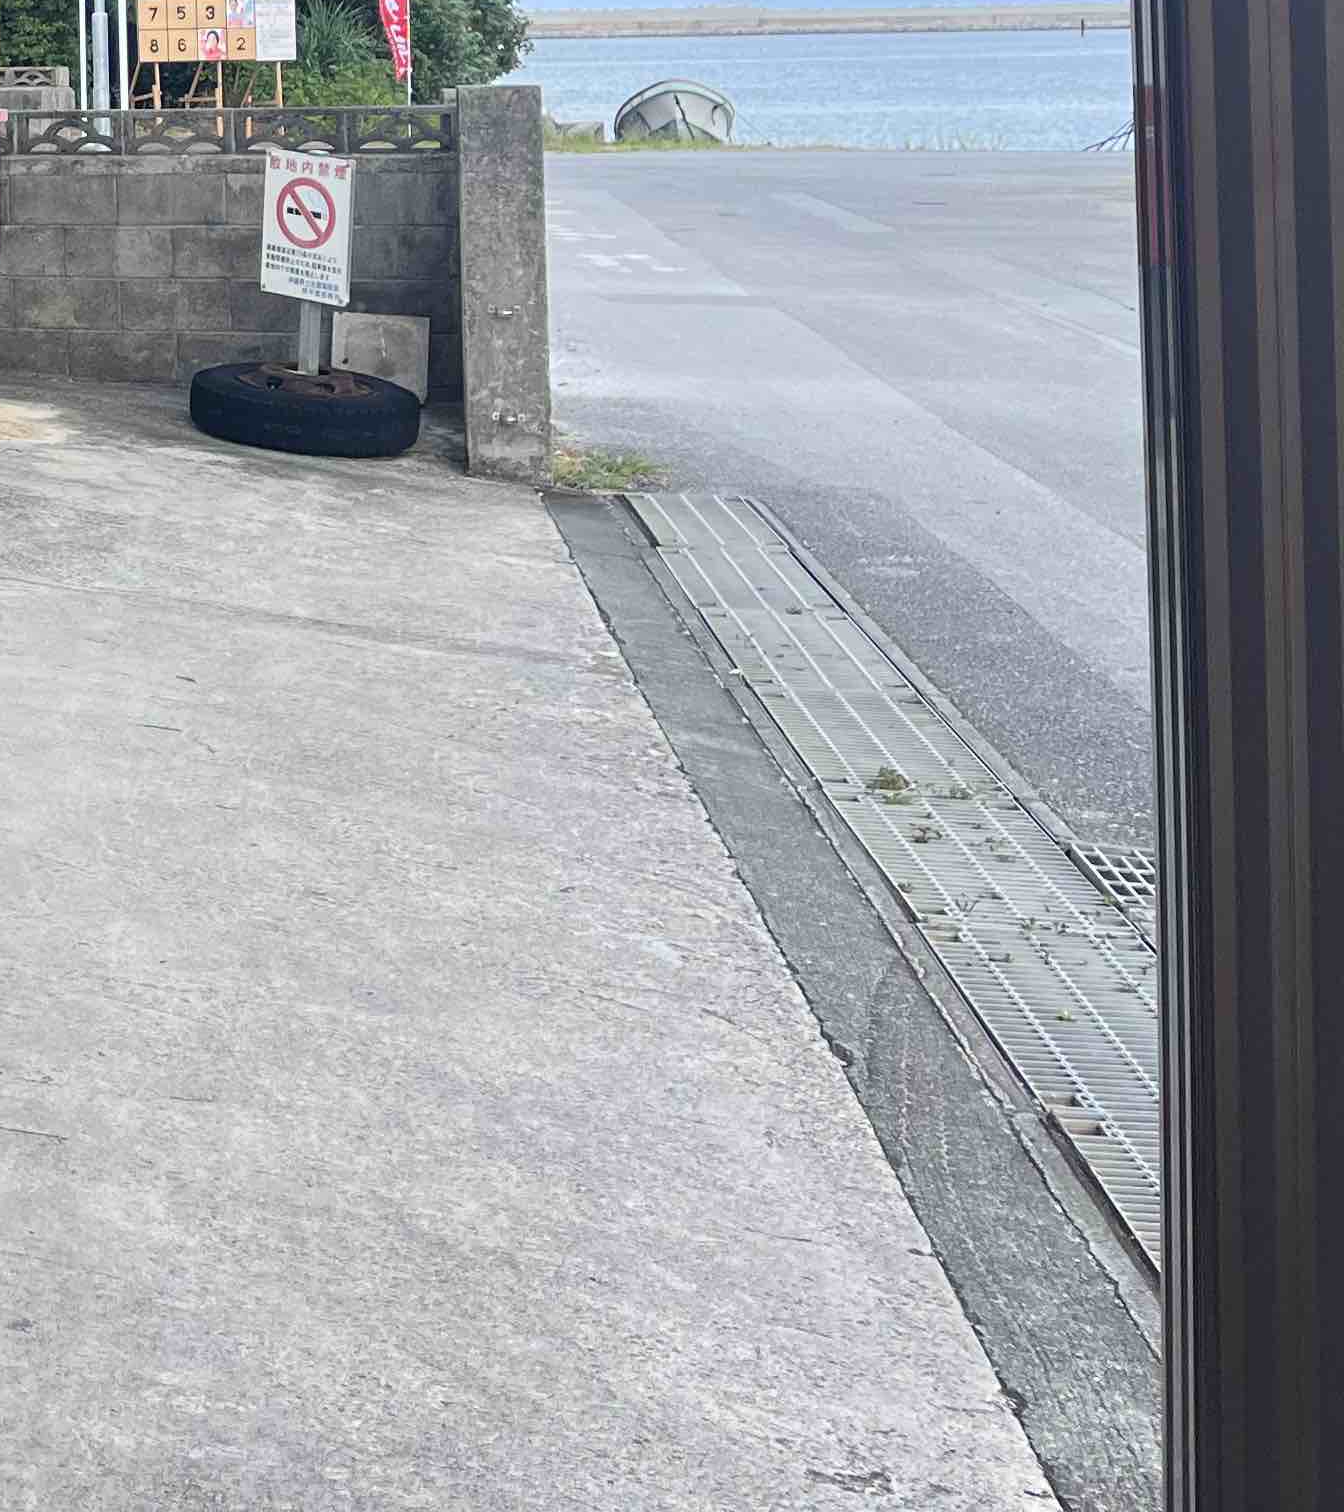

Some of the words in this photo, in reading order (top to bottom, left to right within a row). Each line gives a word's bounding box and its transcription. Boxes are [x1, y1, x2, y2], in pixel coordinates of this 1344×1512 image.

[149, 7, 158, 22] 7
[176, 6, 186, 20] 5
[205, 5, 215, 20] 3
[150, 39, 159, 53] 8
[177, 38, 187, 52] 6
[236, 37, 246, 51] 2
